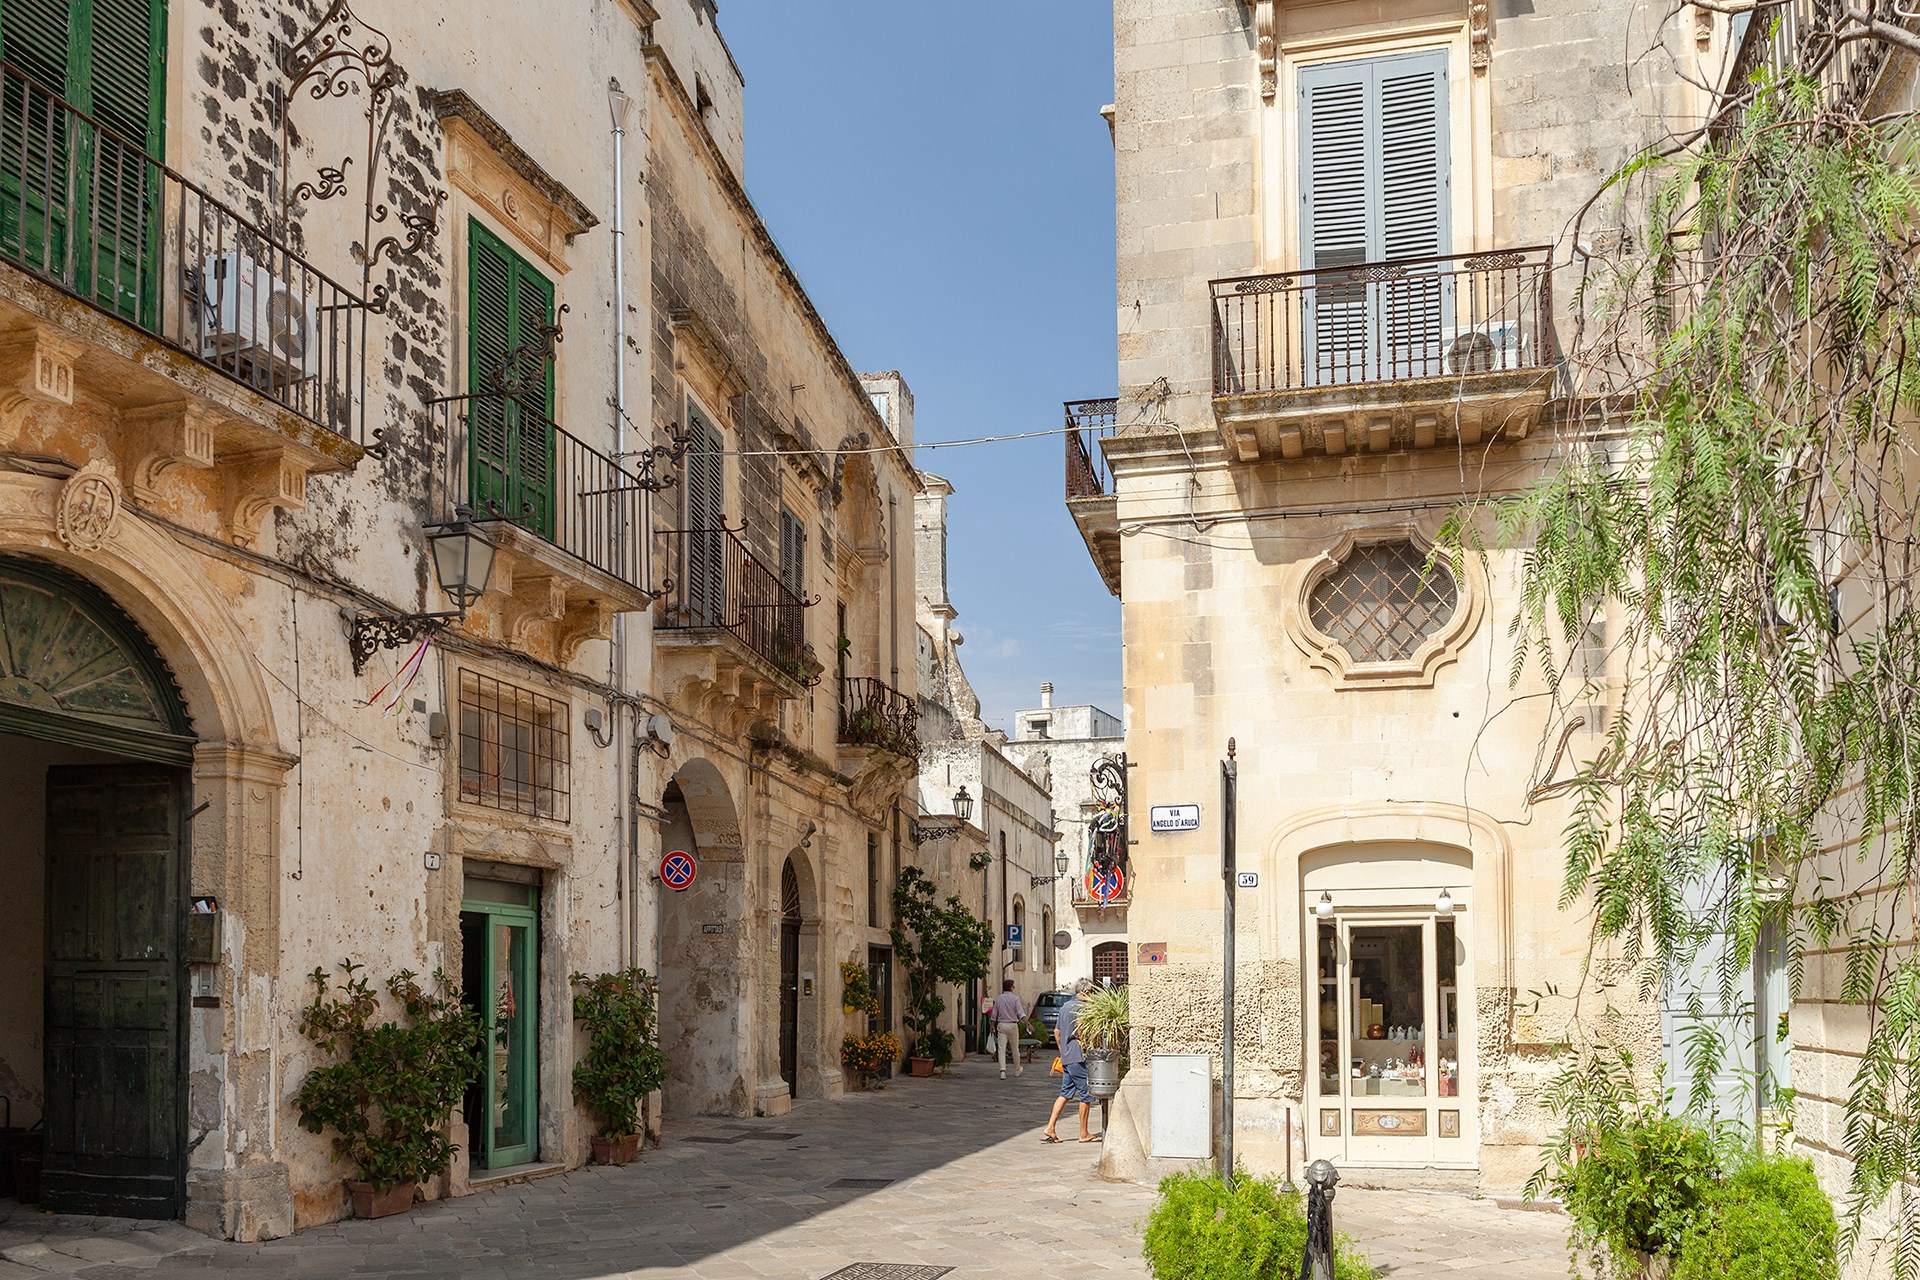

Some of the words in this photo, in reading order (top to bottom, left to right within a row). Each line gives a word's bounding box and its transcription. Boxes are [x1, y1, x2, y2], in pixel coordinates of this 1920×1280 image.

[1169, 809, 1180, 817] VIA
[1152, 819, 1174, 828] ANGELO
[430, 855, 435, 867] 7
[1010, 926, 1019, 940] P
